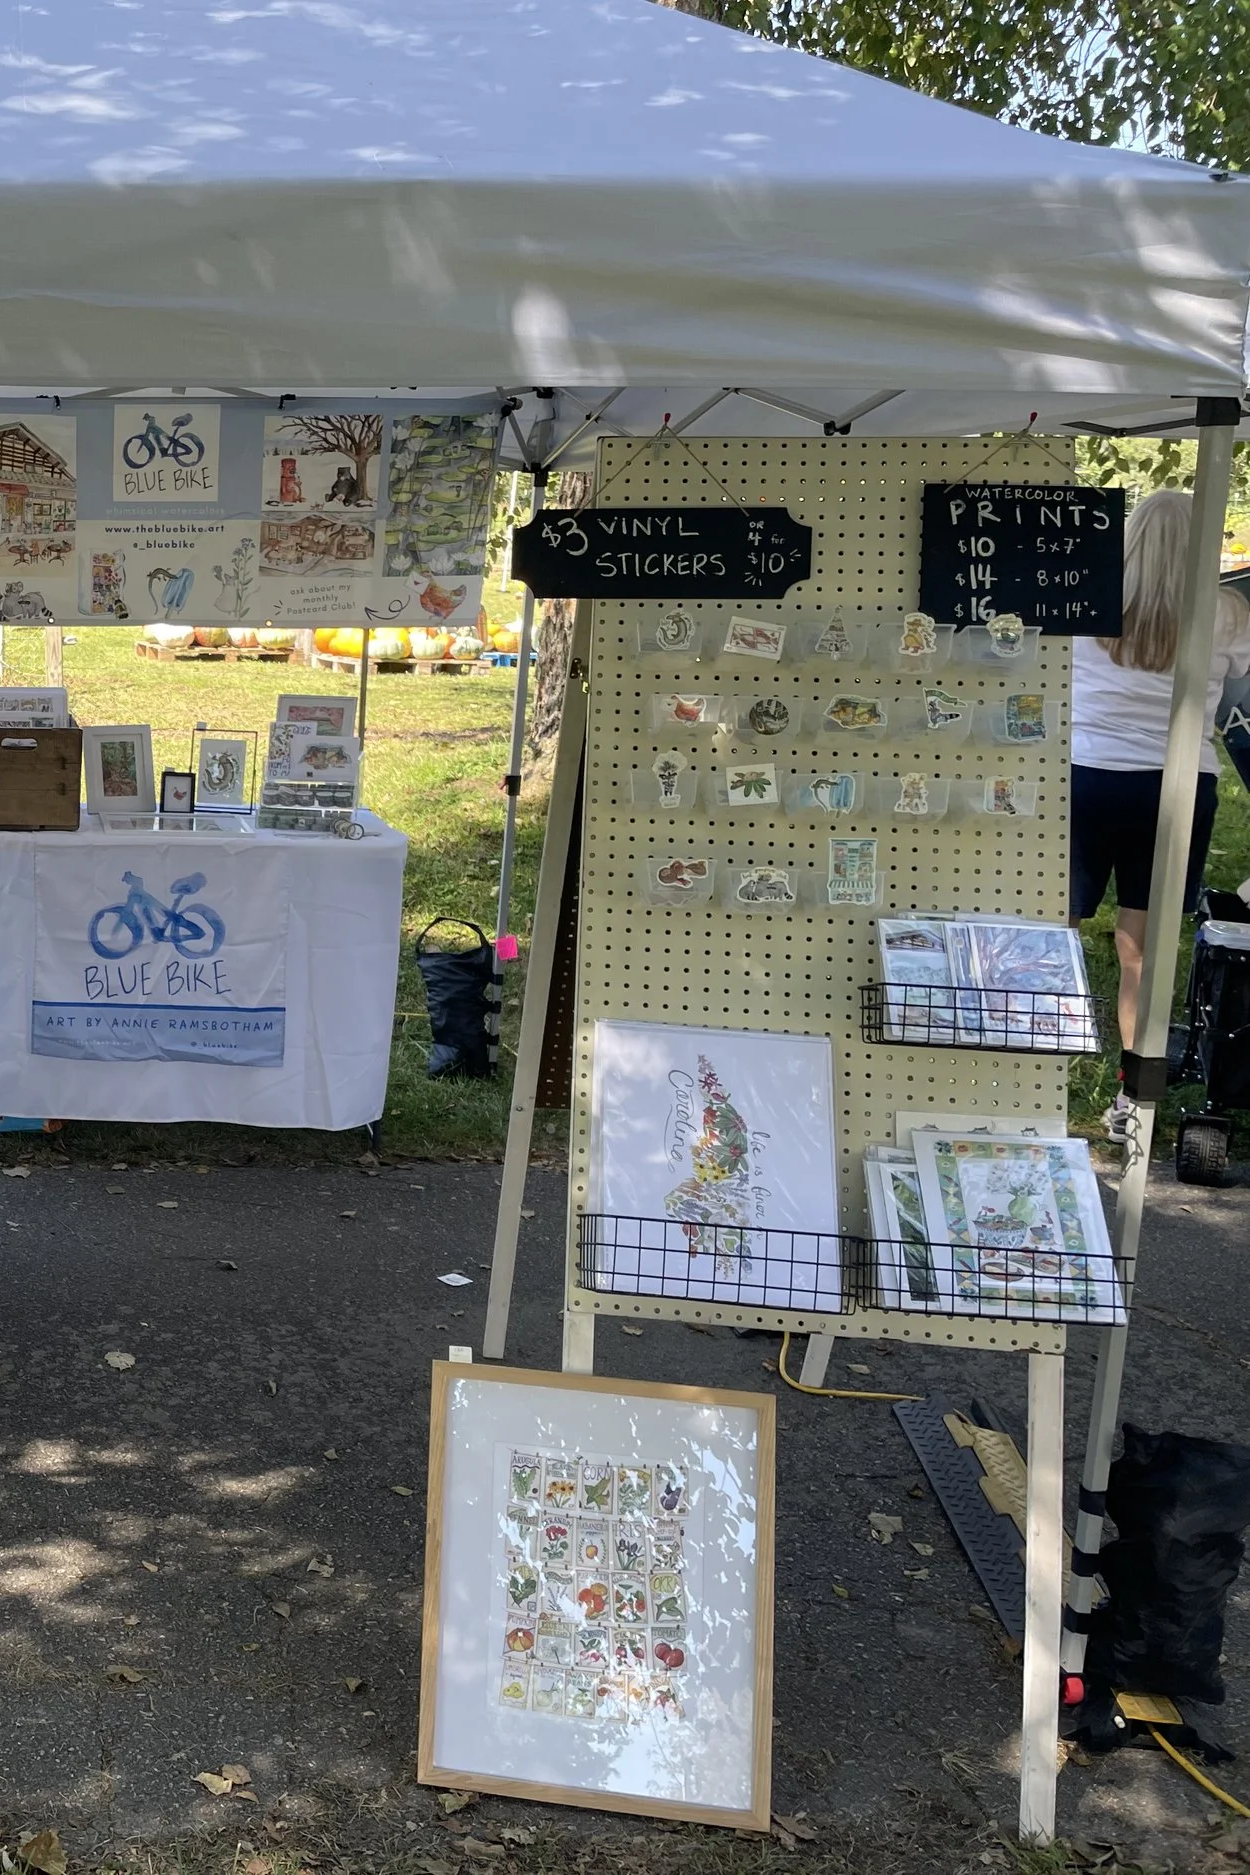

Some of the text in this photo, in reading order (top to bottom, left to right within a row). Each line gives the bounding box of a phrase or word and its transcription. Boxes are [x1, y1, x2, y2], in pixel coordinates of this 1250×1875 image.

[123, 466, 213, 496] BLUE BIKE
[965, 487, 1079, 502] WATERCOLOR
[105, 505, 157, 516] whimsical
[950, 499, 1110, 530] PRINTS
[104, 524, 225, 534] www.thebluebike.art
[749, 520, 764, 529] OR
[541, 515, 700, 556] $3 VINYL
[748, 532, 785, 546] 4 for
[132, 539, 196, 551] @_bluebike
[957, 536, 996, 557] $10
[595, 552, 726, 578] STICKERS
[748, 552, 785, 575] $10
[955, 563, 998, 589] $14
[290, 584, 351, 596] ask about my
[302, 594, 339, 605] monthly
[286, 601, 357, 616] Postcard Club!
[954, 596, 997, 622] $16
[84, 959, 232, 1000] BLUE BIKE
[46, 1016, 274, 1031] ART BY ANNIE RAMSBOTHAM
[751, 1130, 771, 1159] life
[754, 1166, 763, 1177] is
[583, 1465, 612, 1481] CORN
[614, 1522, 643, 1539] IRIS
